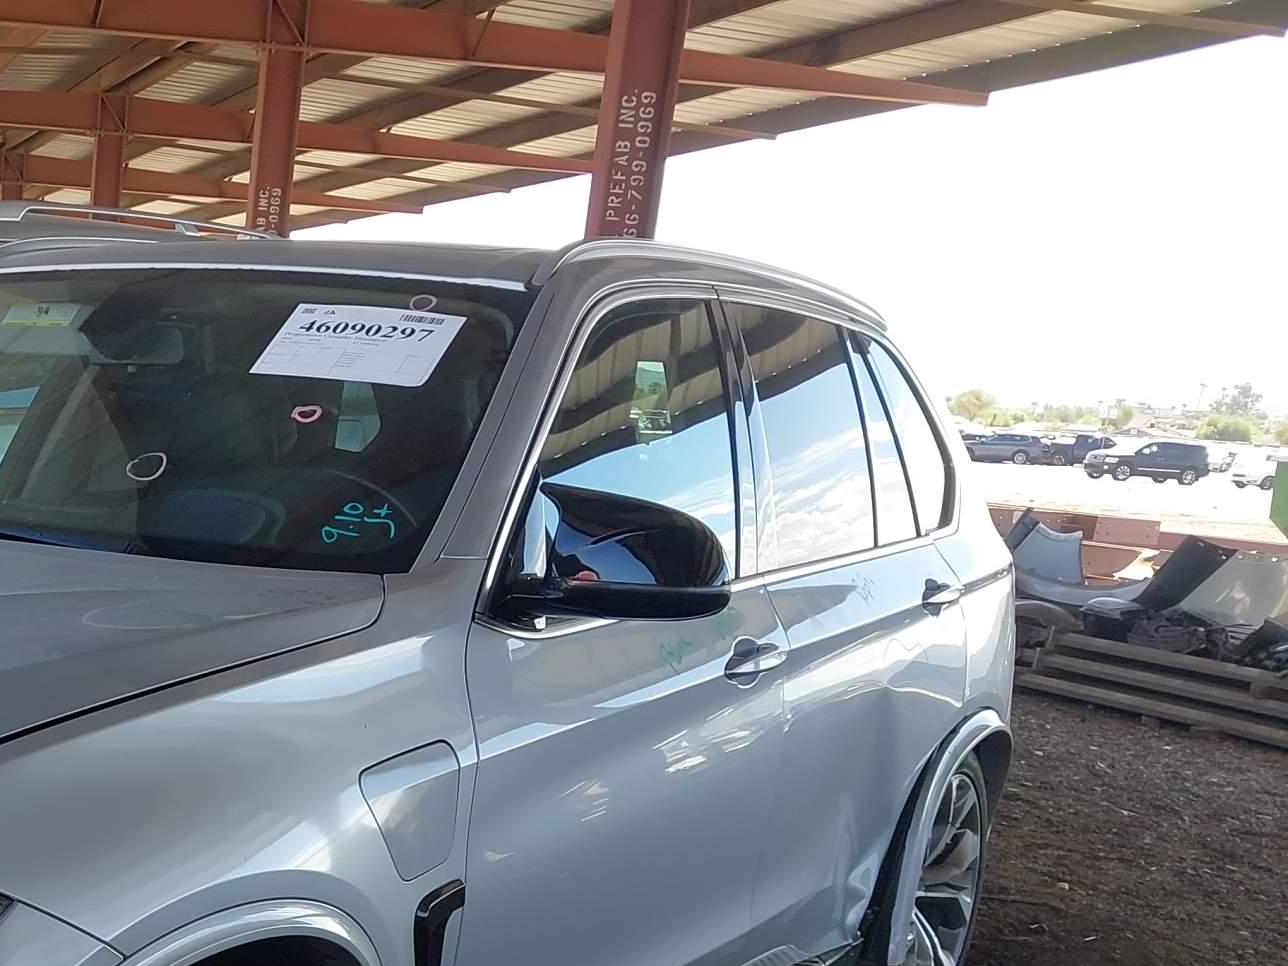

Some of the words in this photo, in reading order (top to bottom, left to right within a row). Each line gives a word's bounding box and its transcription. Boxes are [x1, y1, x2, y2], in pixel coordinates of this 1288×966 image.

[605, 140, 631, 221] PREFAB
[618, 89, 638, 128] INC.
[257, 186, 270, 211] INC.
[299, 319, 435, 342] 46090297
[321, 502, 364, 543] 9.10
